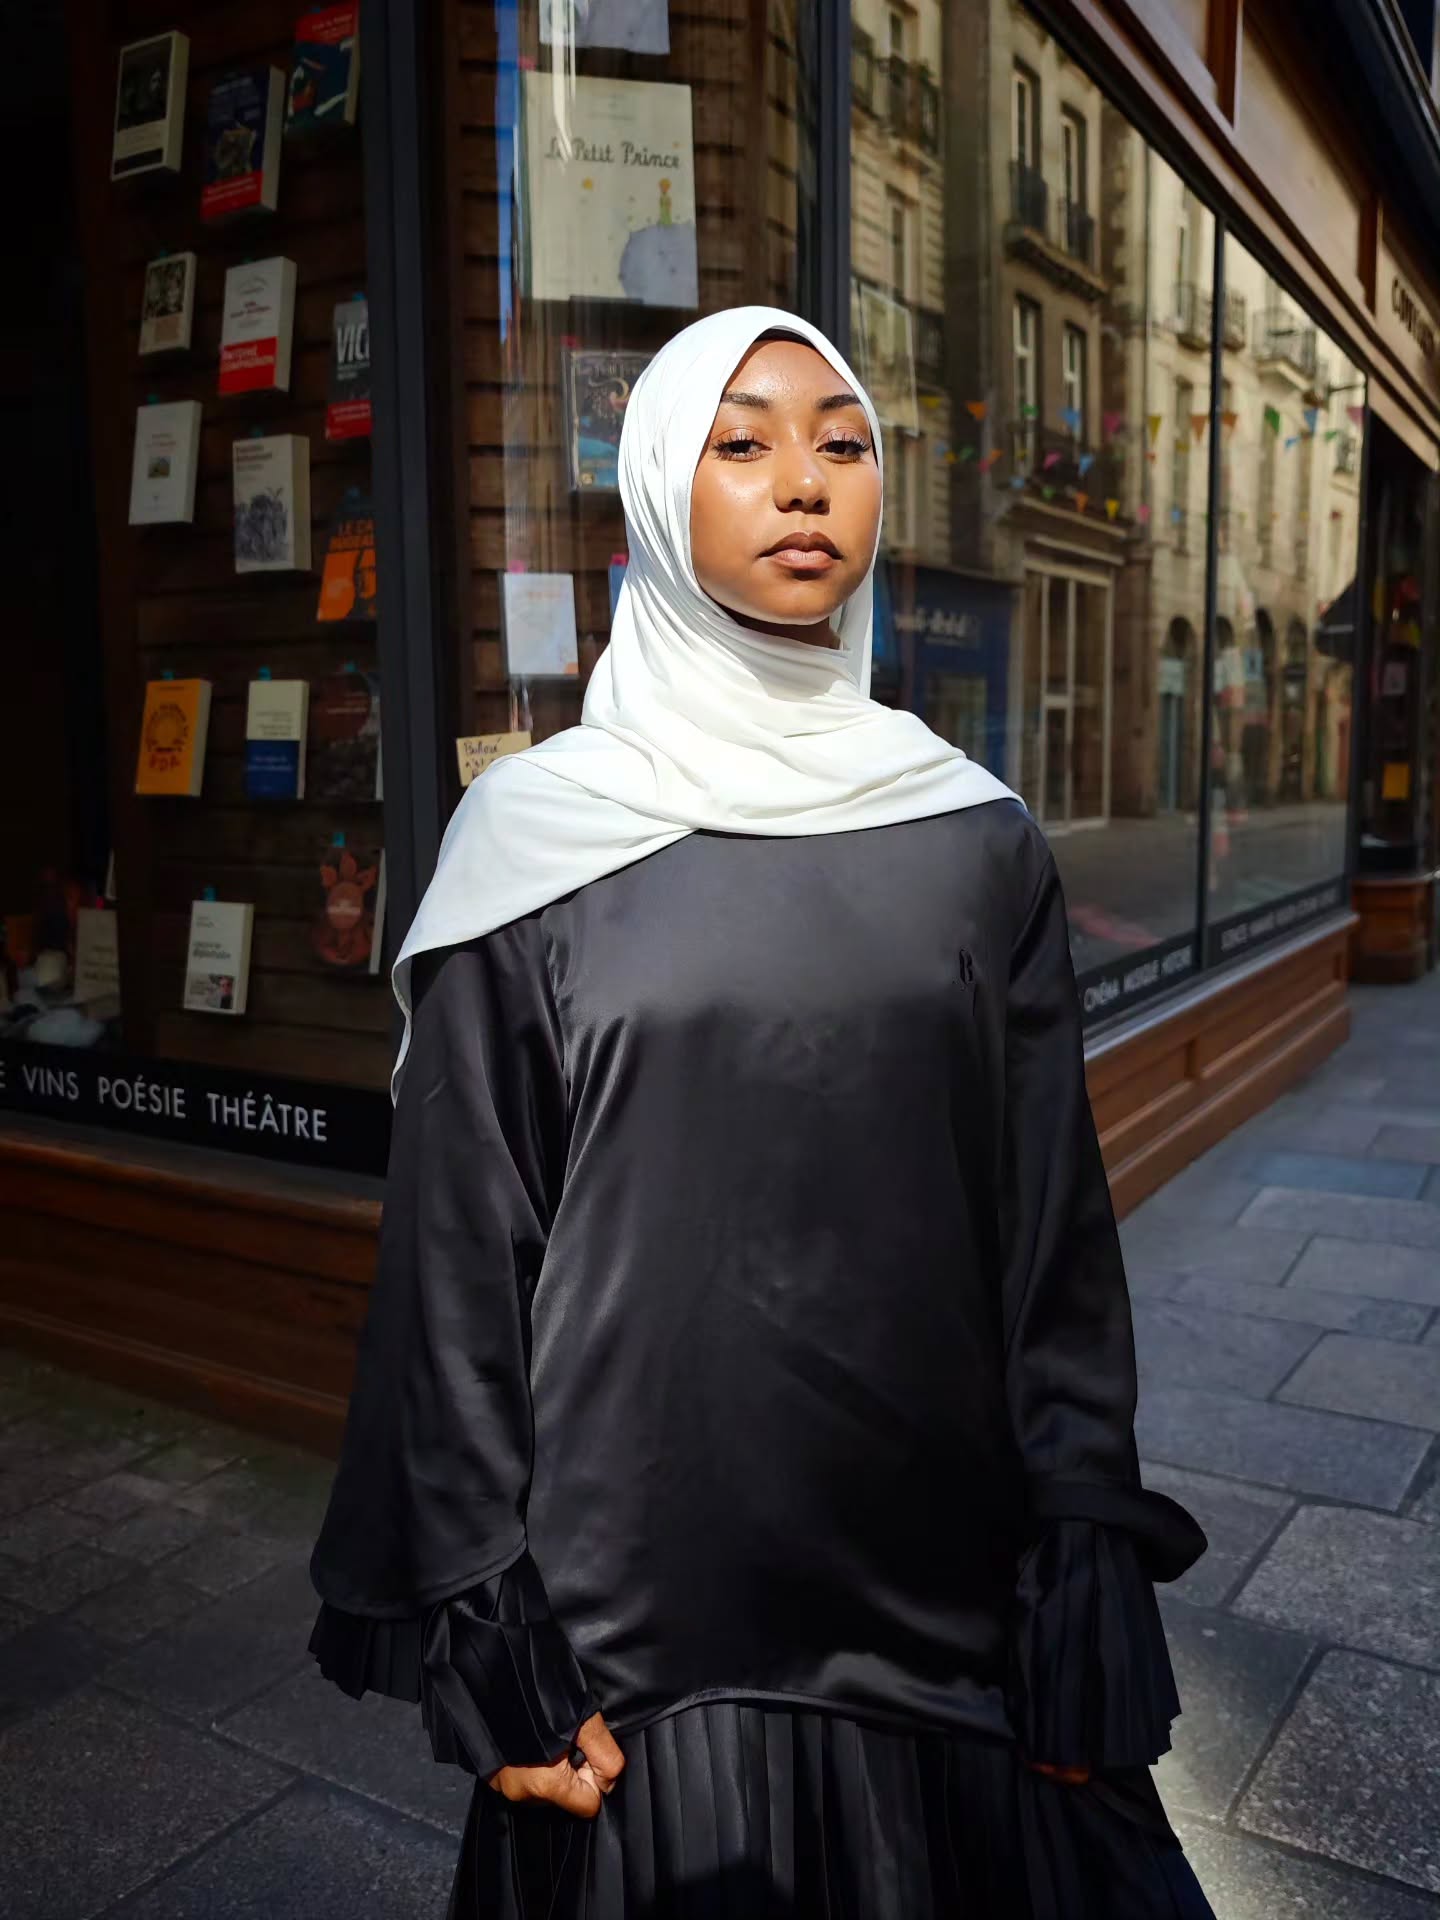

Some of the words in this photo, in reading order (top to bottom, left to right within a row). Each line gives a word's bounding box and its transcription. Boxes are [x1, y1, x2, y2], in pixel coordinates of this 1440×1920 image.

[572, 137, 616, 165] Petit
[621, 141, 680, 169] Prince
[336, 323, 370, 364] VIC
[22, 1063, 80, 1101] VINS
[97, 1074, 187, 1119] POÉSIE
[206, 1091, 328, 1143] THÉÂTRE
